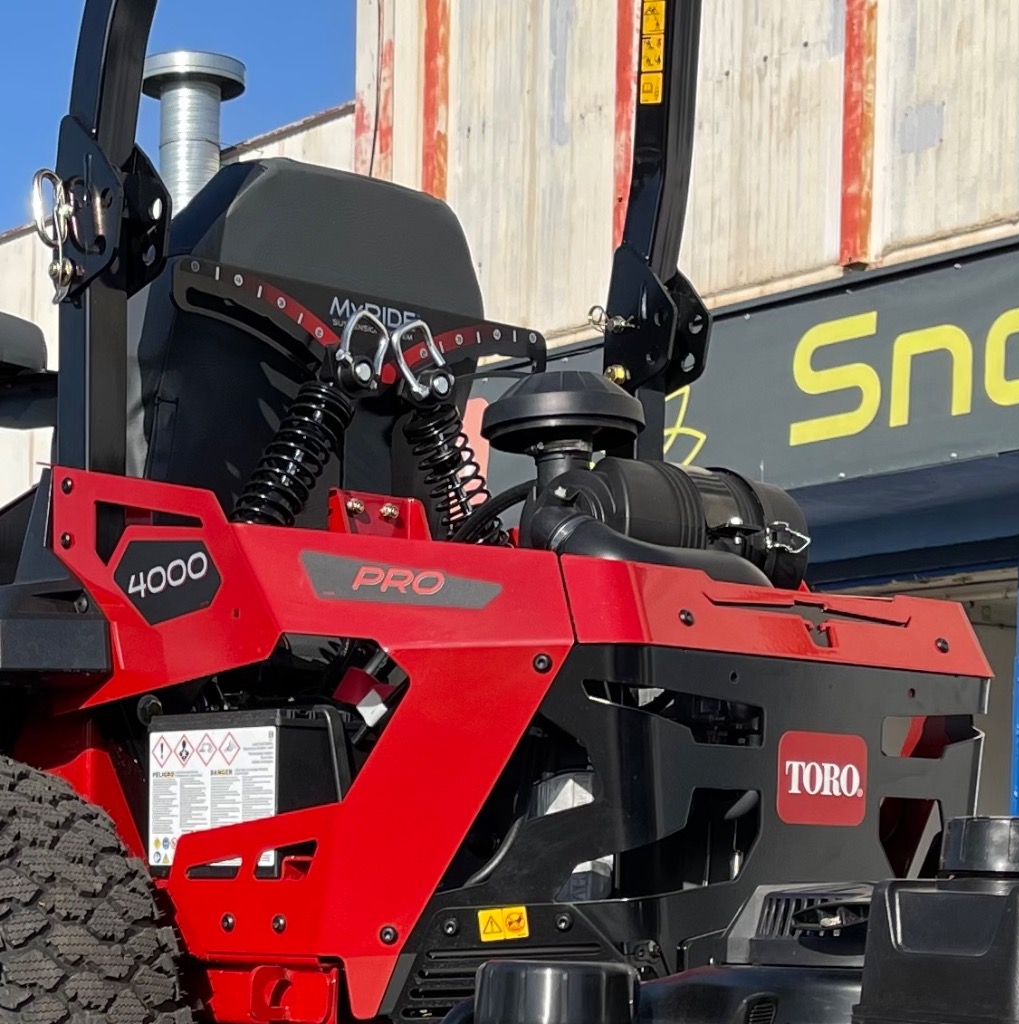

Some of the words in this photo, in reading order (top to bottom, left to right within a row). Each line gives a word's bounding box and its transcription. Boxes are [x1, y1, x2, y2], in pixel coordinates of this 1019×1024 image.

[128, 551, 208, 598] 4000
[352, 566, 445, 595] PRO
[785, 761, 861, 797] TORO
